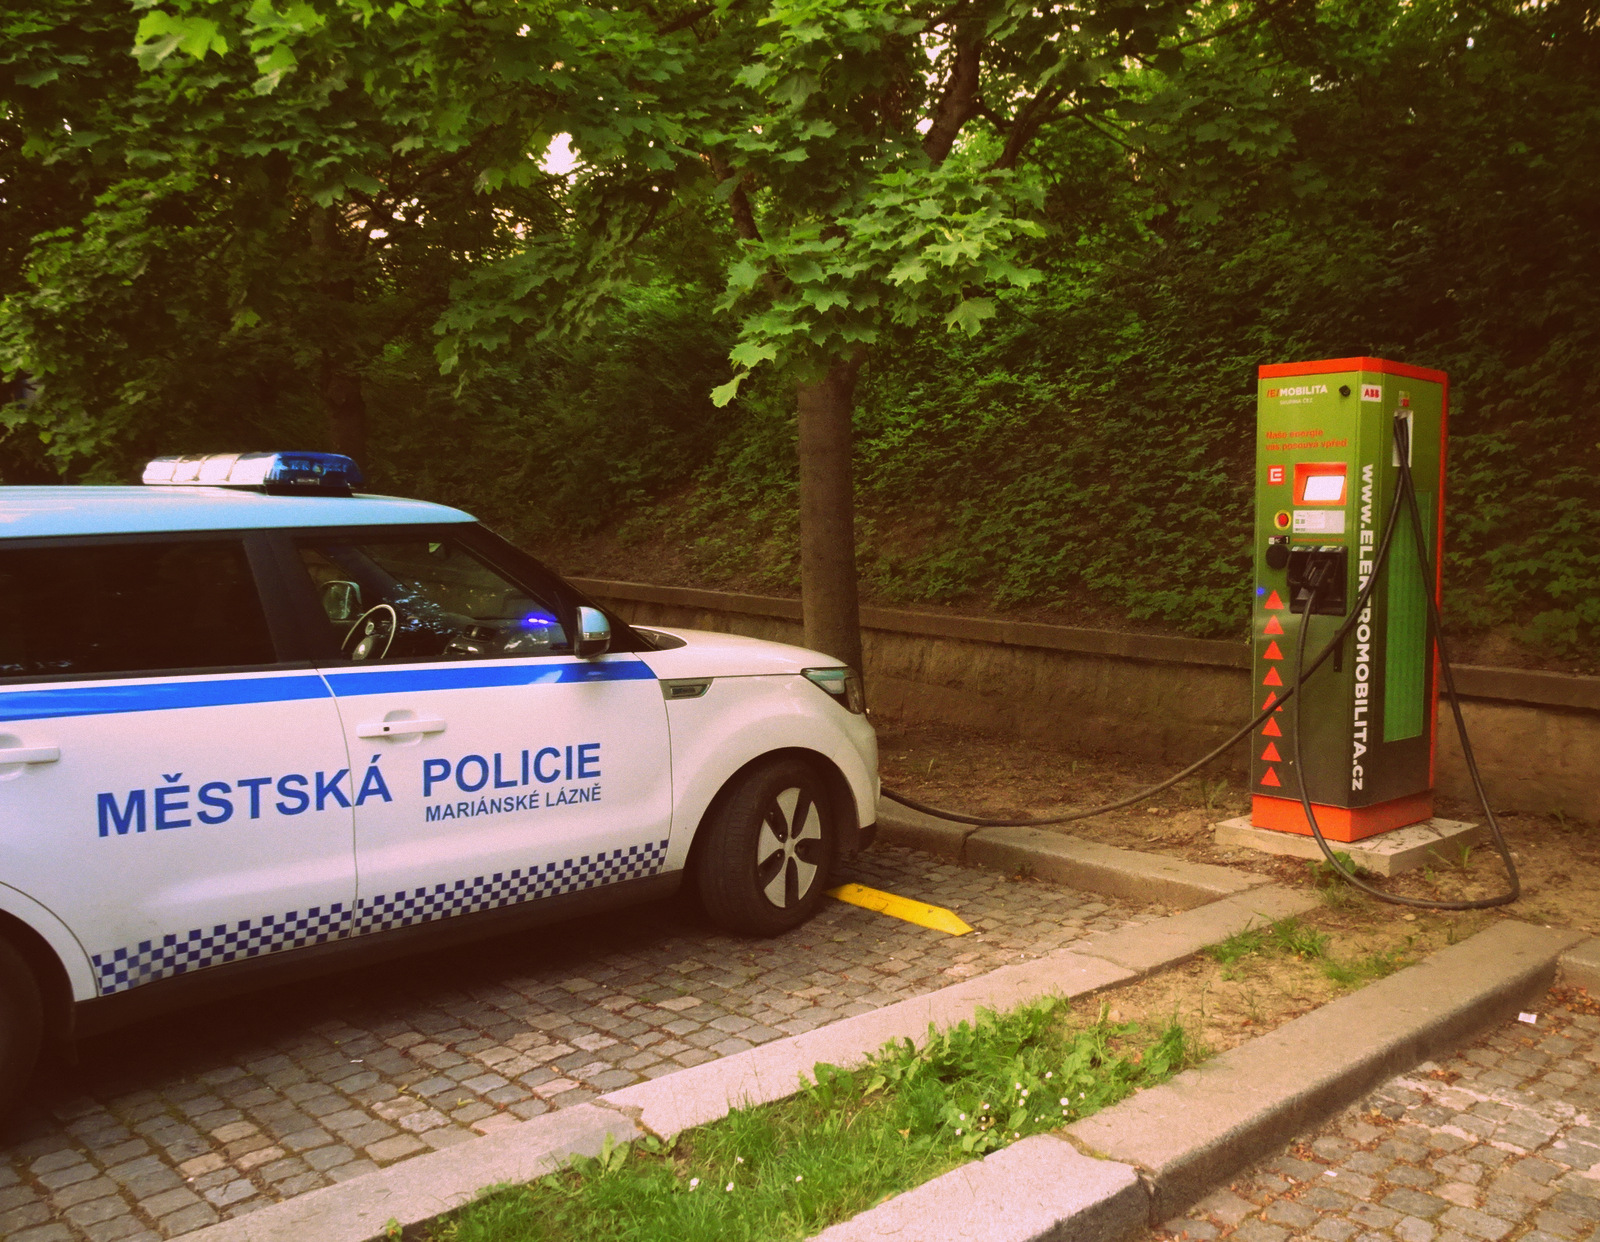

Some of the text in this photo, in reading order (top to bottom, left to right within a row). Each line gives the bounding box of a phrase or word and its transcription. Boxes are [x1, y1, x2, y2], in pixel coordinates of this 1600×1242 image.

[1364, 388, 1380, 398] ABB
[1351, 463, 1374, 791] www.ELEKROMOBILITA.cz
[97, 753, 393, 837] MĚSTSKÁ
[423, 742, 601, 797] POLICIE
[425, 783, 601, 822] MARIÁNSKÉ LÁZNĚ
